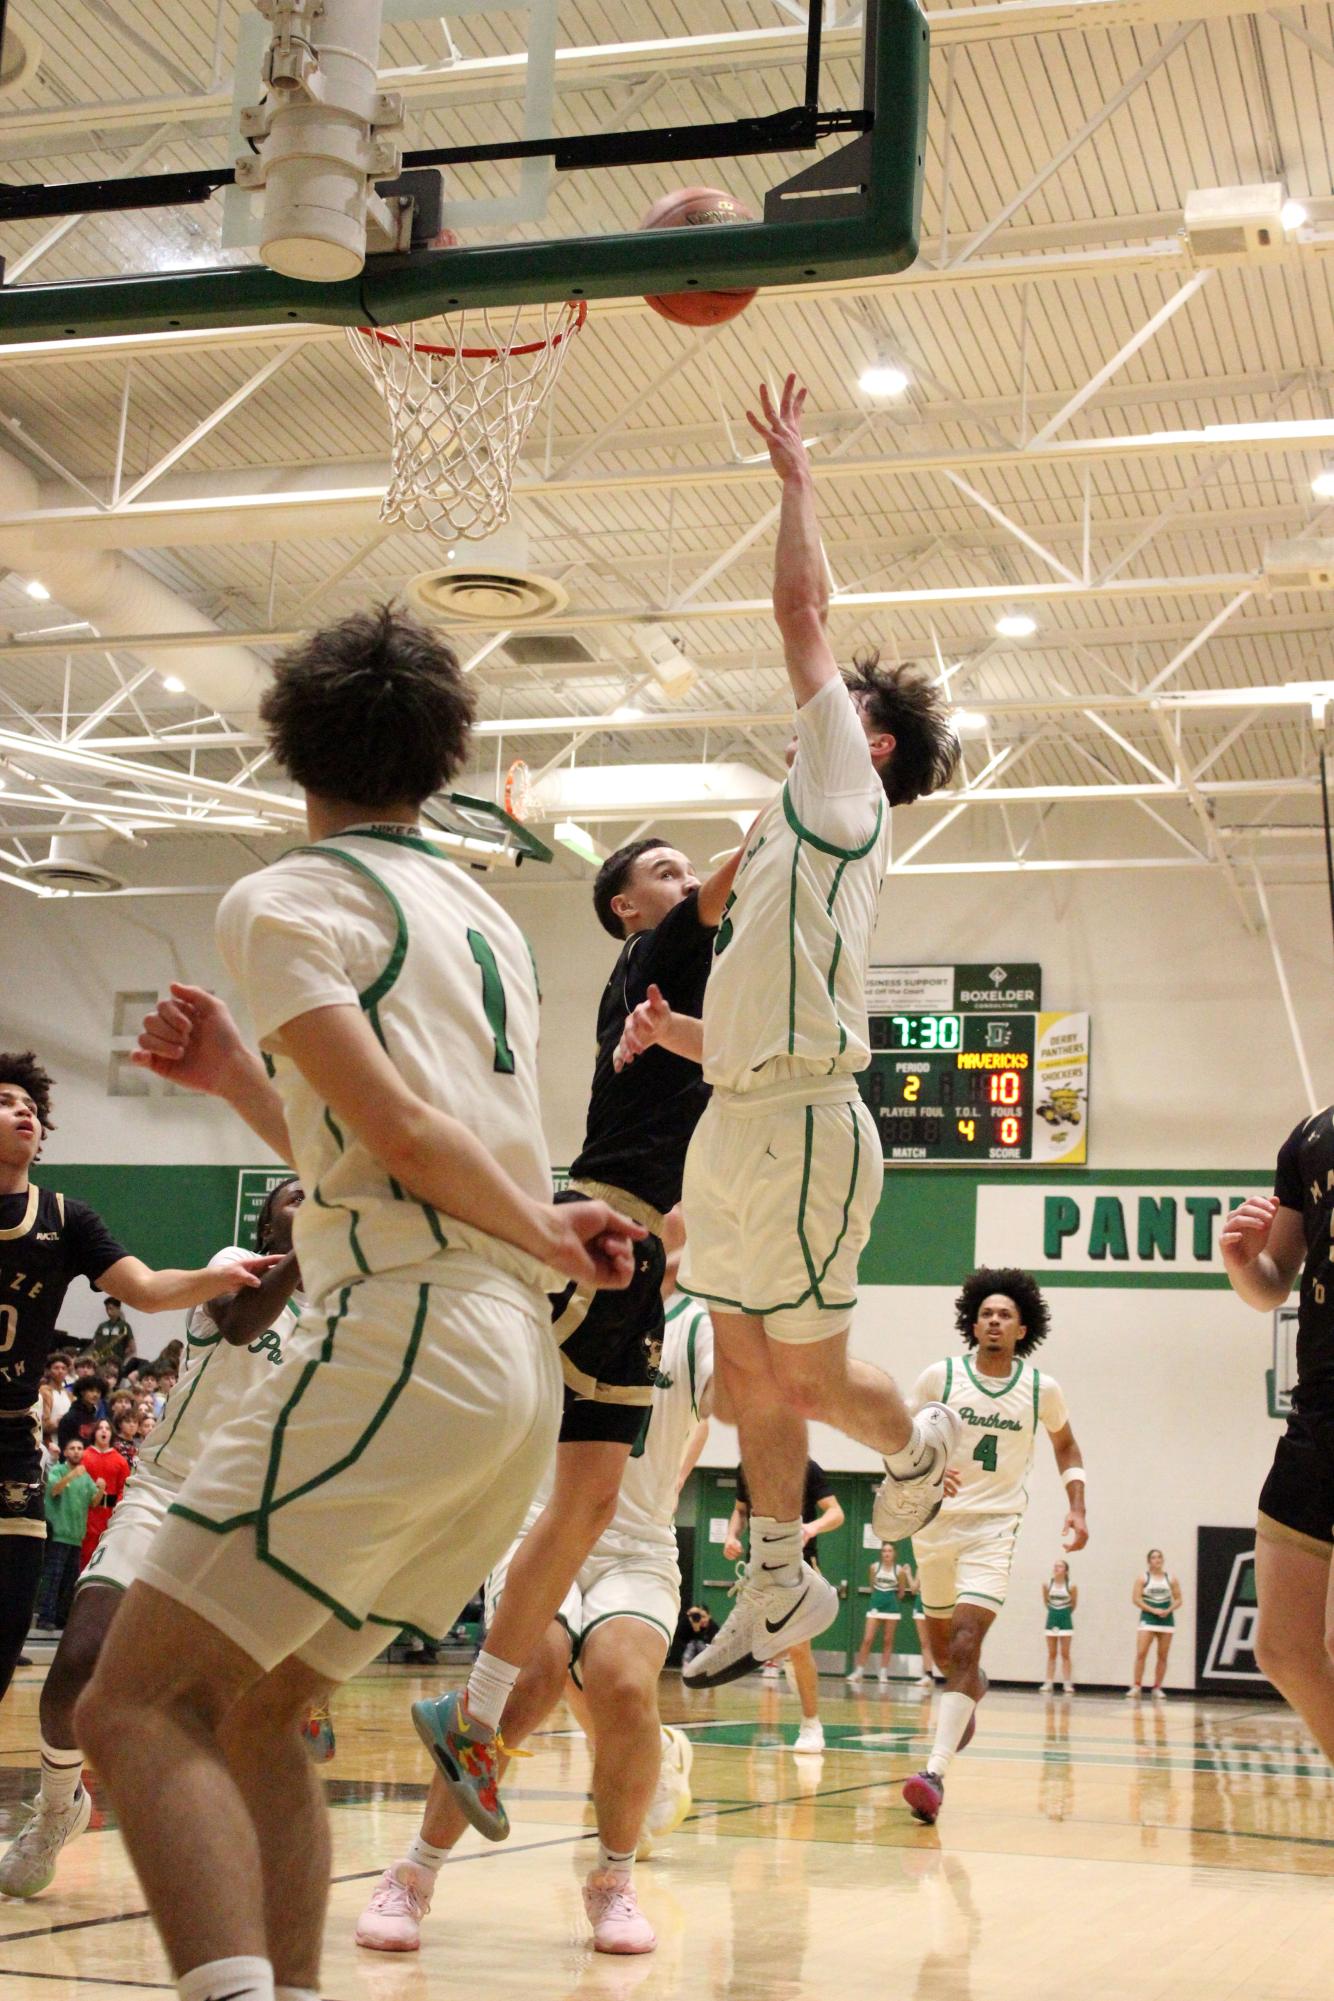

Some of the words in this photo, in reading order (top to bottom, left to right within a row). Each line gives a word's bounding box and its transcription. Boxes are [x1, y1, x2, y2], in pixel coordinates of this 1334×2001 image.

[904, 978, 948, 987] SUPPORT
[466, 928, 515, 1075] 1
[960, 990, 1034, 1002] BOXELDER
[892, 1017, 960, 1049] 7:30
[1050, 1033, 1078, 1046] DERBY
[1041, 1042, 1084, 1058] PANTHERS
[895, 1062, 931, 1073] PERIOD
[957, 1053, 1029, 1069] MAVERICKS
[903, 1075, 921, 1102] 2
[990, 1071, 1021, 1104] 10
[880, 1107, 917, 1118] PLAYER
[920, 1107, 945, 1118] FOUL
[991, 1107, 1023, 1118] FOULS
[958, 1119, 976, 1142] 4
[1001, 1117, 1019, 1144] 0
[892, 1148, 927, 1159] MATCH
[989, 1148, 1021, 1159] SCORE
[1043, 1196, 1245, 1262] PANT
[0, 1268, 43, 1299] ZE
[958, 1406, 1023, 1432] Panthers
[973, 1434, 998, 1472] 4
